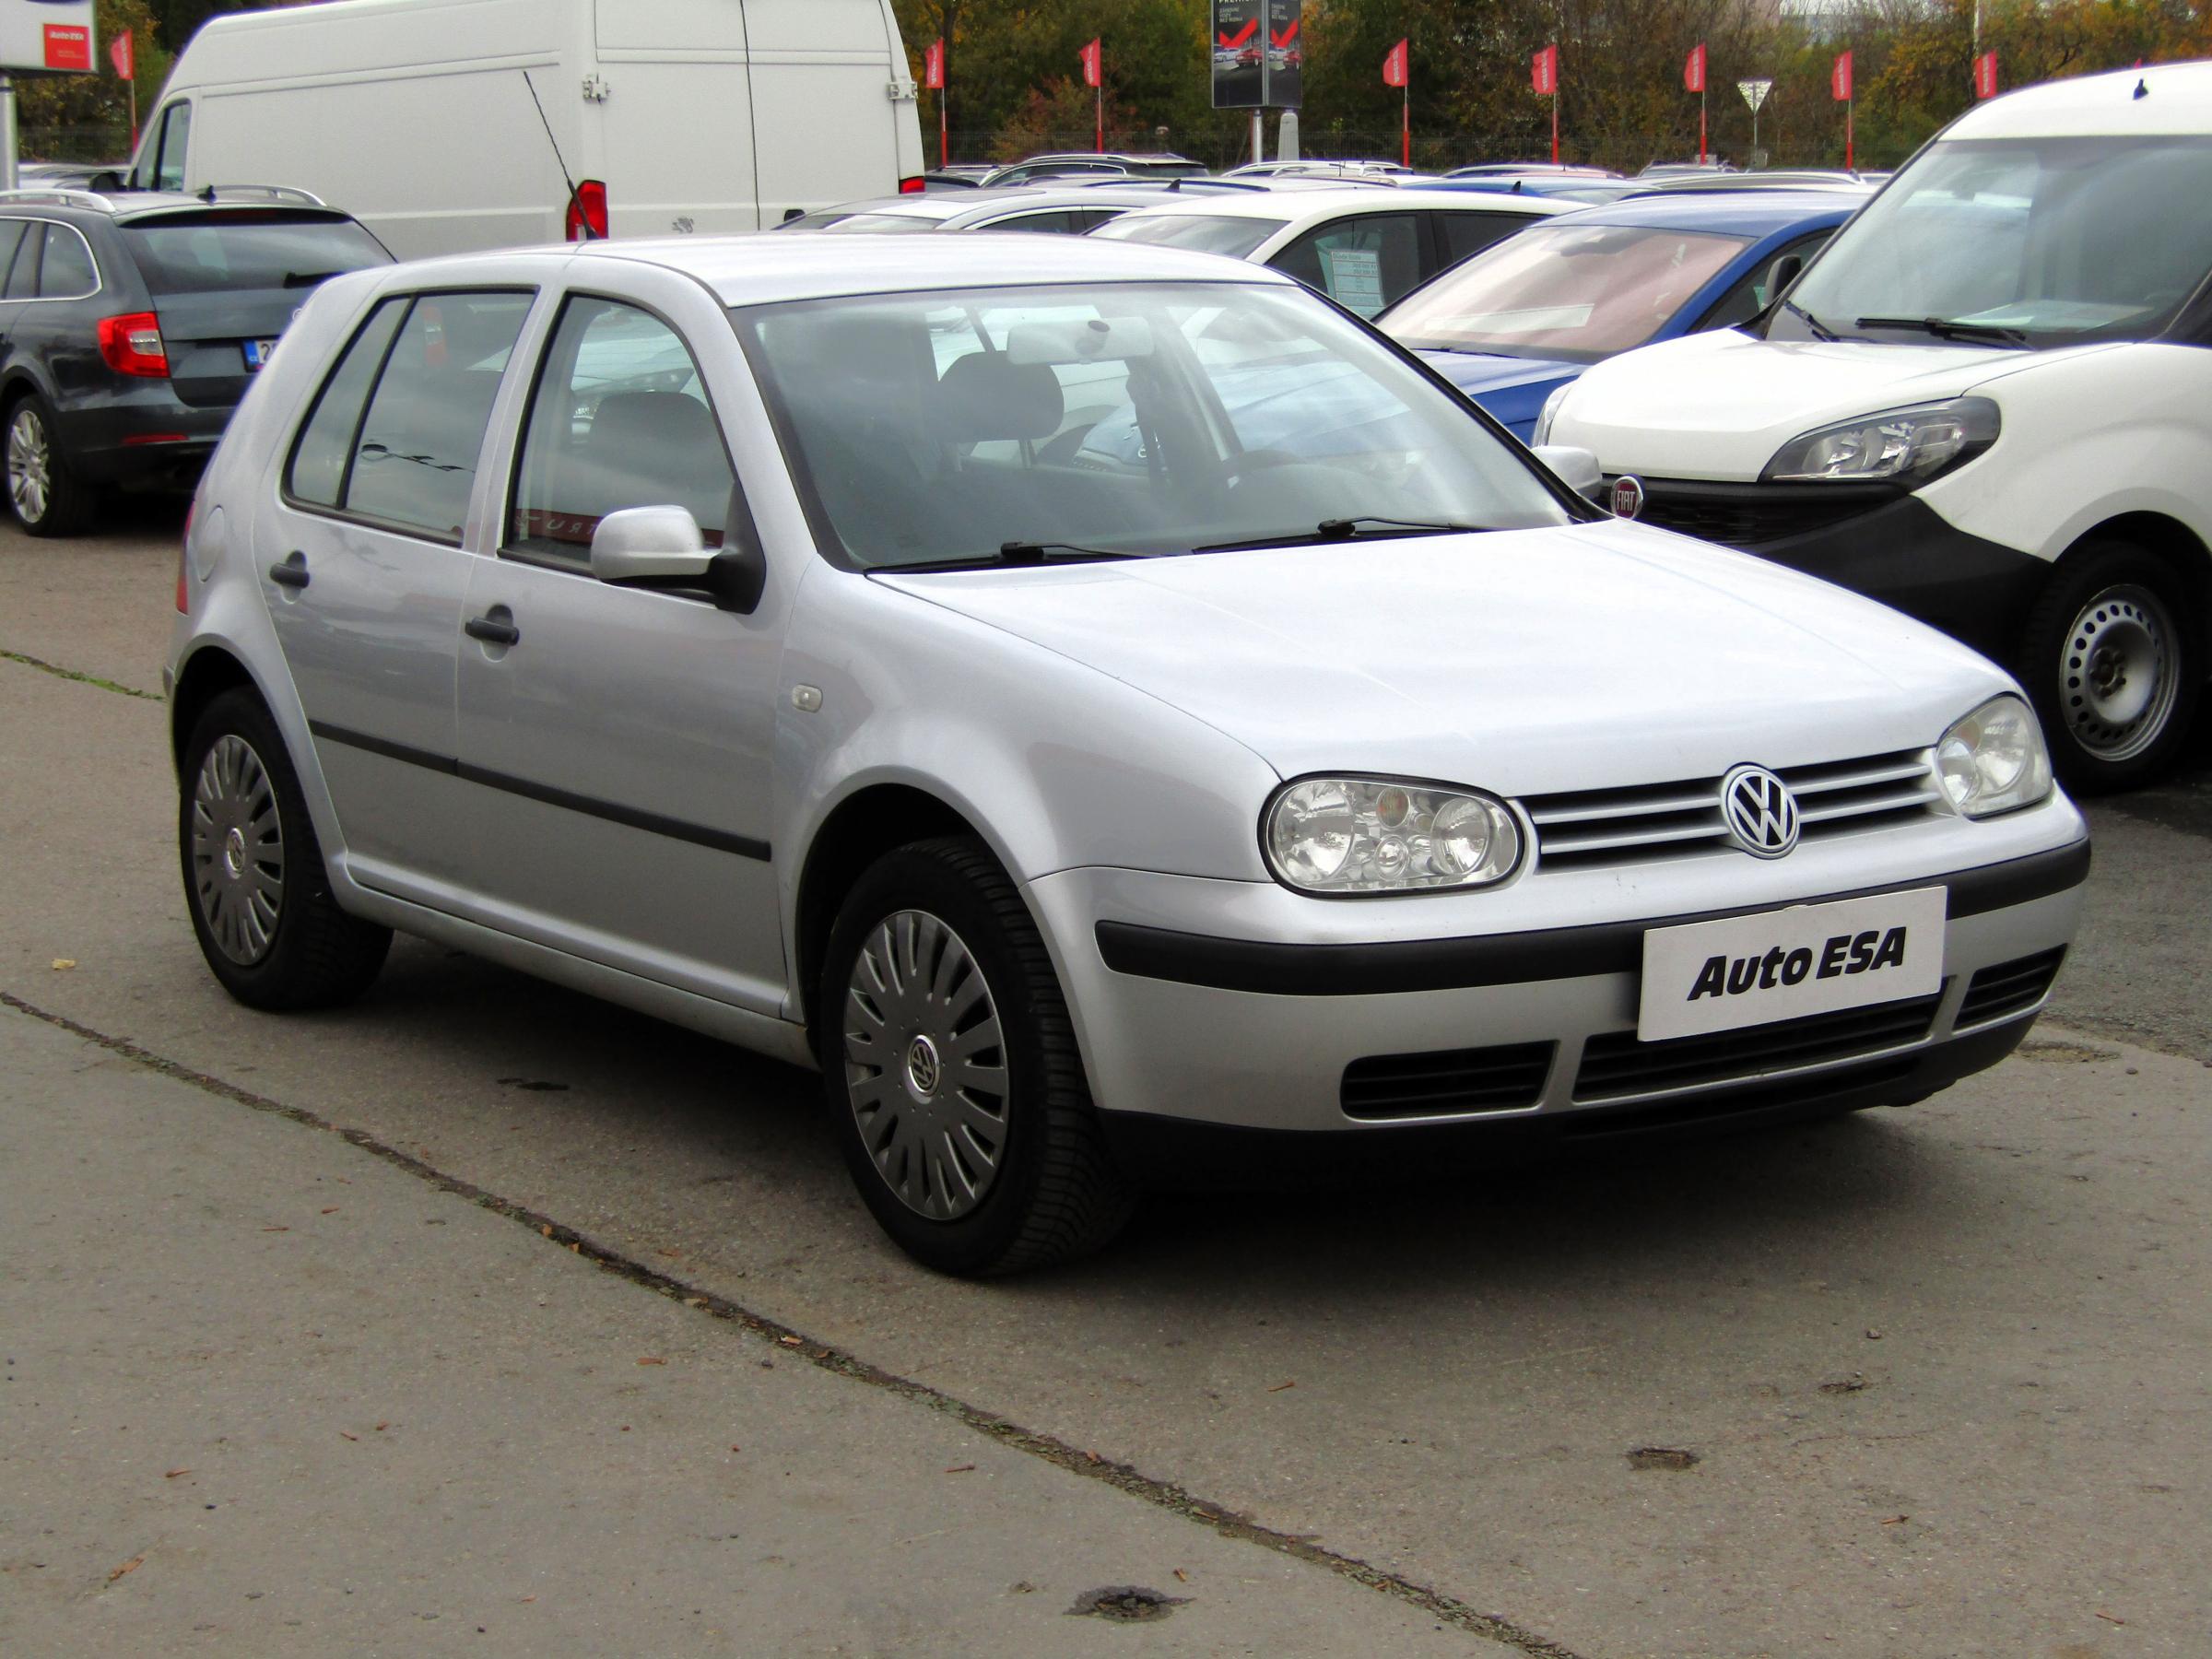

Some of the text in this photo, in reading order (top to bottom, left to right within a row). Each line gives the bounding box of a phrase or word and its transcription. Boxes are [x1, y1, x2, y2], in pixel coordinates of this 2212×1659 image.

[1617, 490, 1636, 512] FIAT
[1728, 771, 1796, 849] VW
[1687, 926, 1907, 1001] Auto ESA
[911, 1042, 935, 1088] VW
